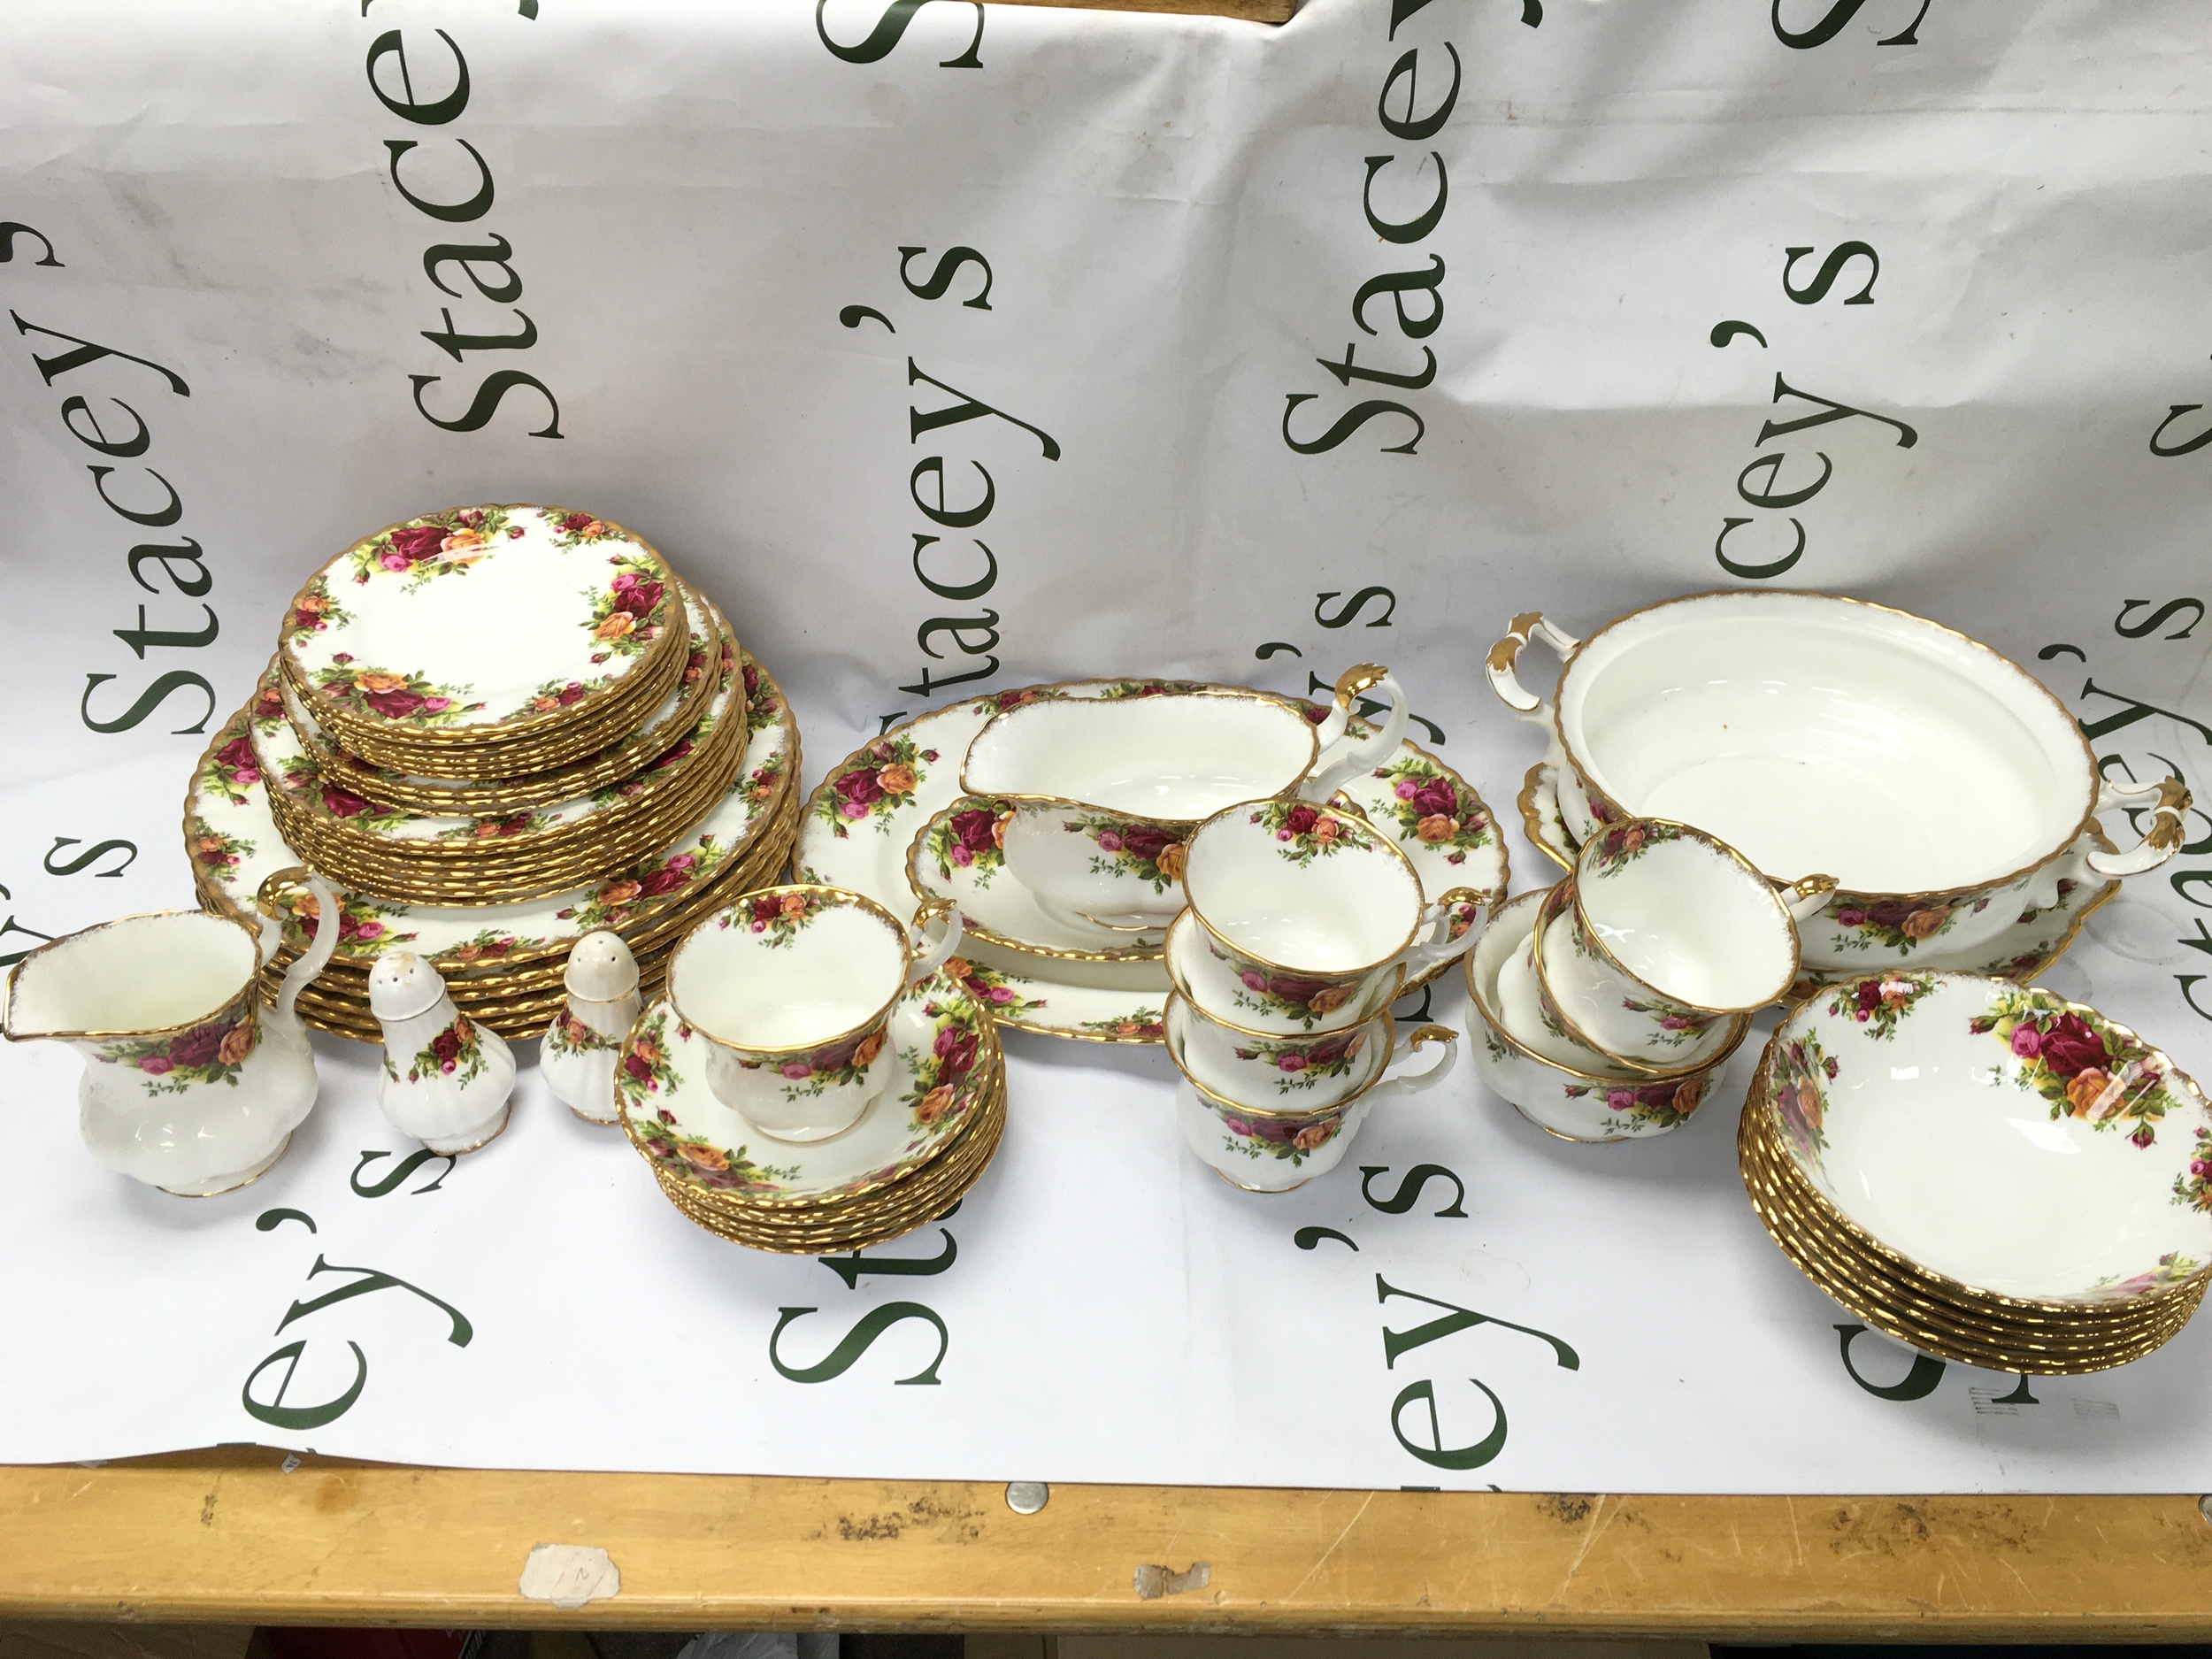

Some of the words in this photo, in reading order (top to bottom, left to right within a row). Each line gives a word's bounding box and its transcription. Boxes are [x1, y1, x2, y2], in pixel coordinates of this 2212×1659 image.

[361, 0, 565, 441] Stace
[1282, 0, 1543, 456] Stace
[839, 246, 1062, 737] tacey's
[216, 1147, 474, 1455] ey's
[768, 1196, 964, 1386] St
[1294, 1164, 1581, 1493] ey's
